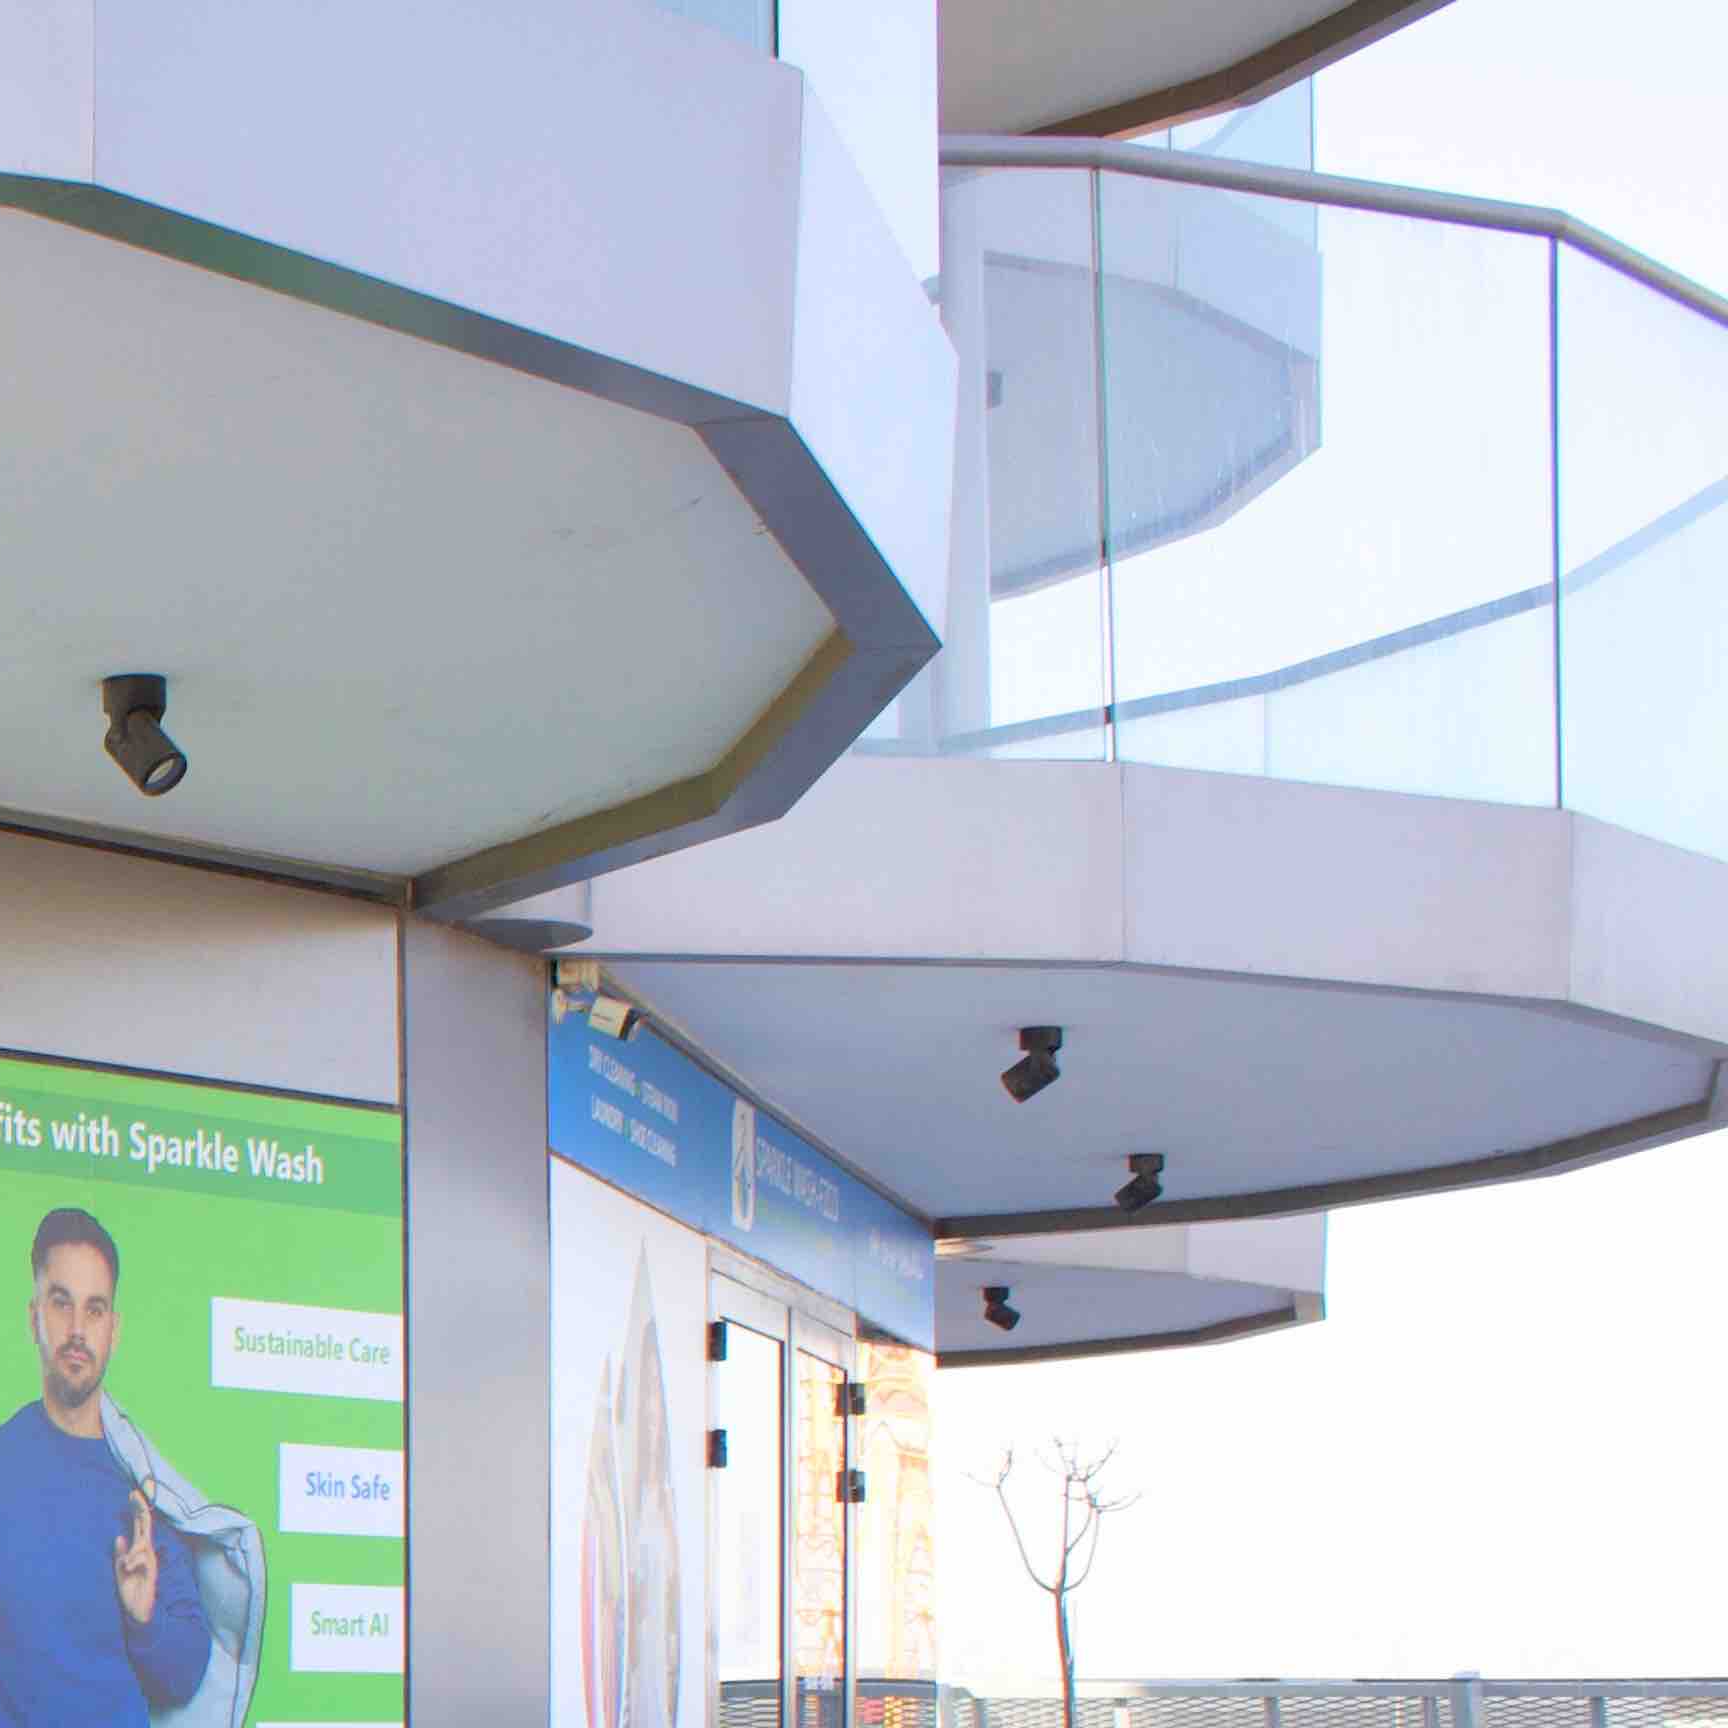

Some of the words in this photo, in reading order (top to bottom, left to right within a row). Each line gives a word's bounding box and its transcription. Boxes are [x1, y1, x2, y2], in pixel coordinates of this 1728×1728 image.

[51, 1112, 120, 1158] with
[129, 1122, 239, 1176] Sparkle
[248, 1138, 325, 1186] Wash
[233, 1323, 344, 1363] Sustainable
[348, 1337, 391, 1366] Care
[305, 1471, 344, 1499] Skin
[349, 1473, 391, 1501] Safe
[310, 1611, 366, 1637] Smart
